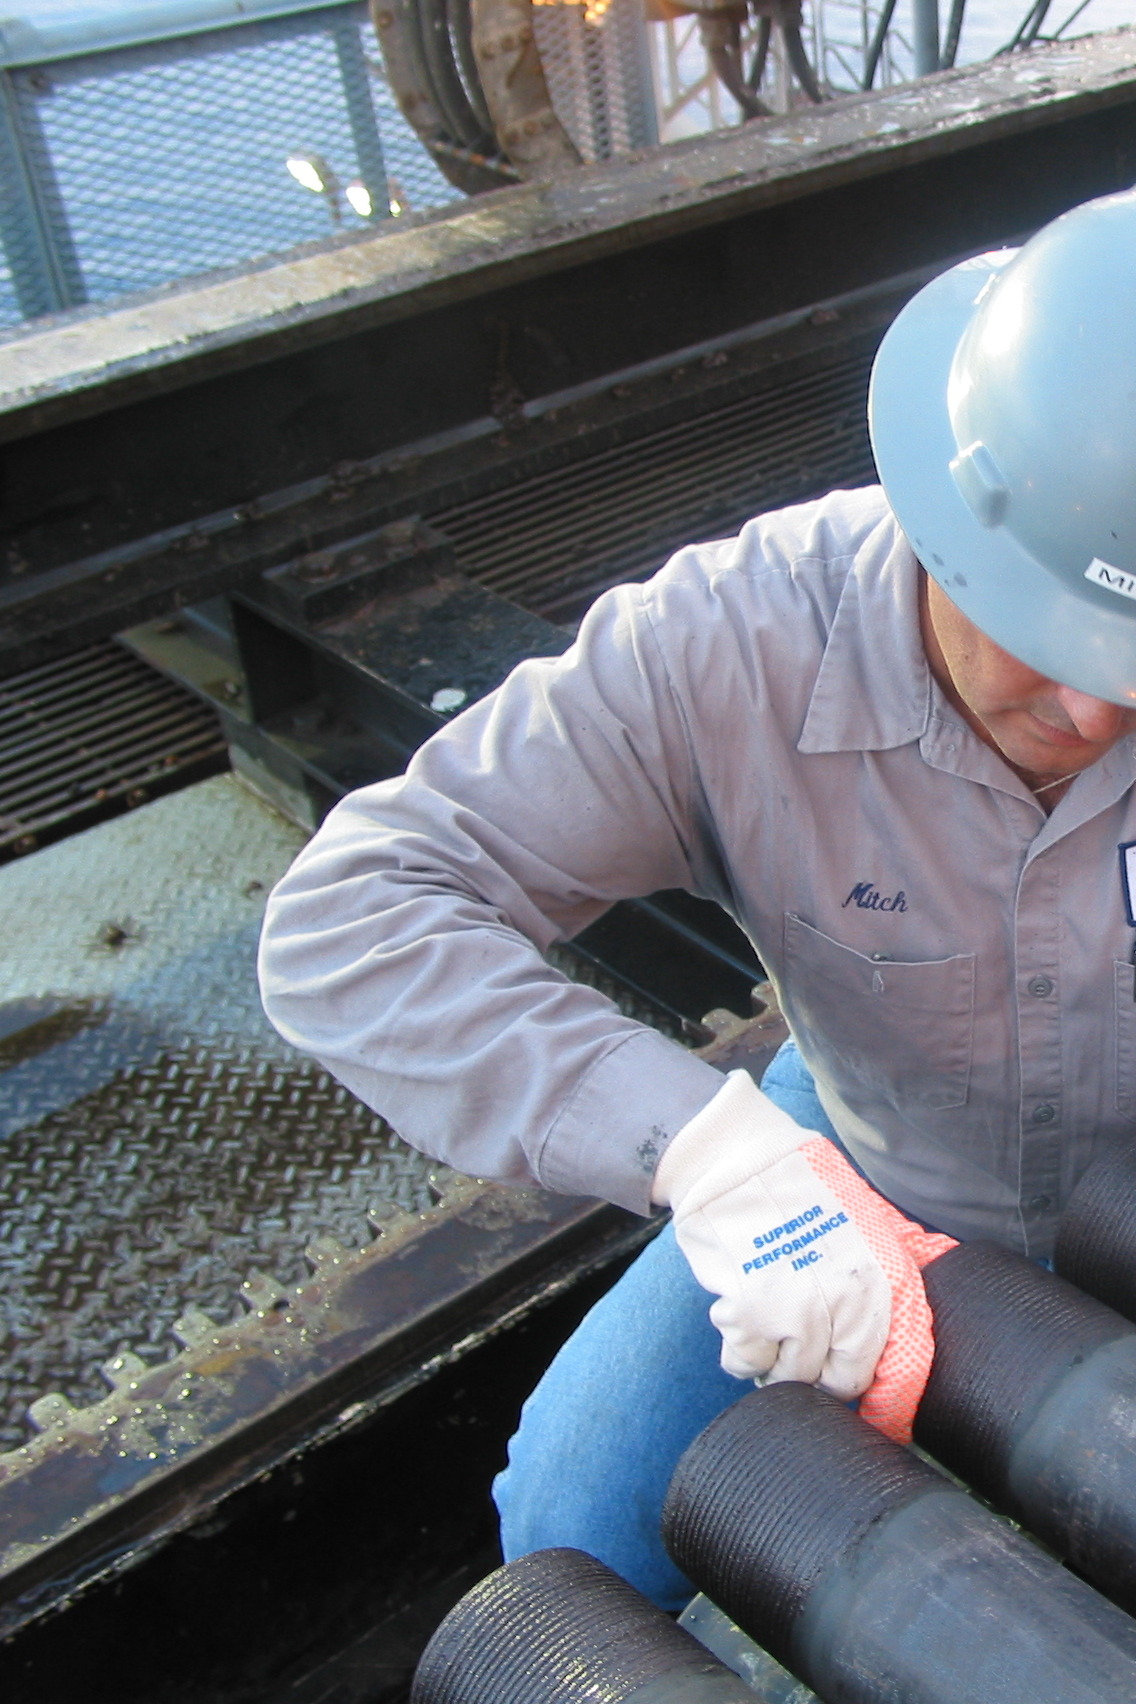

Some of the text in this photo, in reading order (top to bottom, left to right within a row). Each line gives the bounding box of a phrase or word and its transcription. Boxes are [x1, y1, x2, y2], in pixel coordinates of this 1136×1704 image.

[841, 882, 908, 913] Mitch
[742, 1211, 850, 1275] PERFORMANCE
[752, 1205, 825, 1250] SUPERIOR
[791, 1250, 824, 1272] INC.
